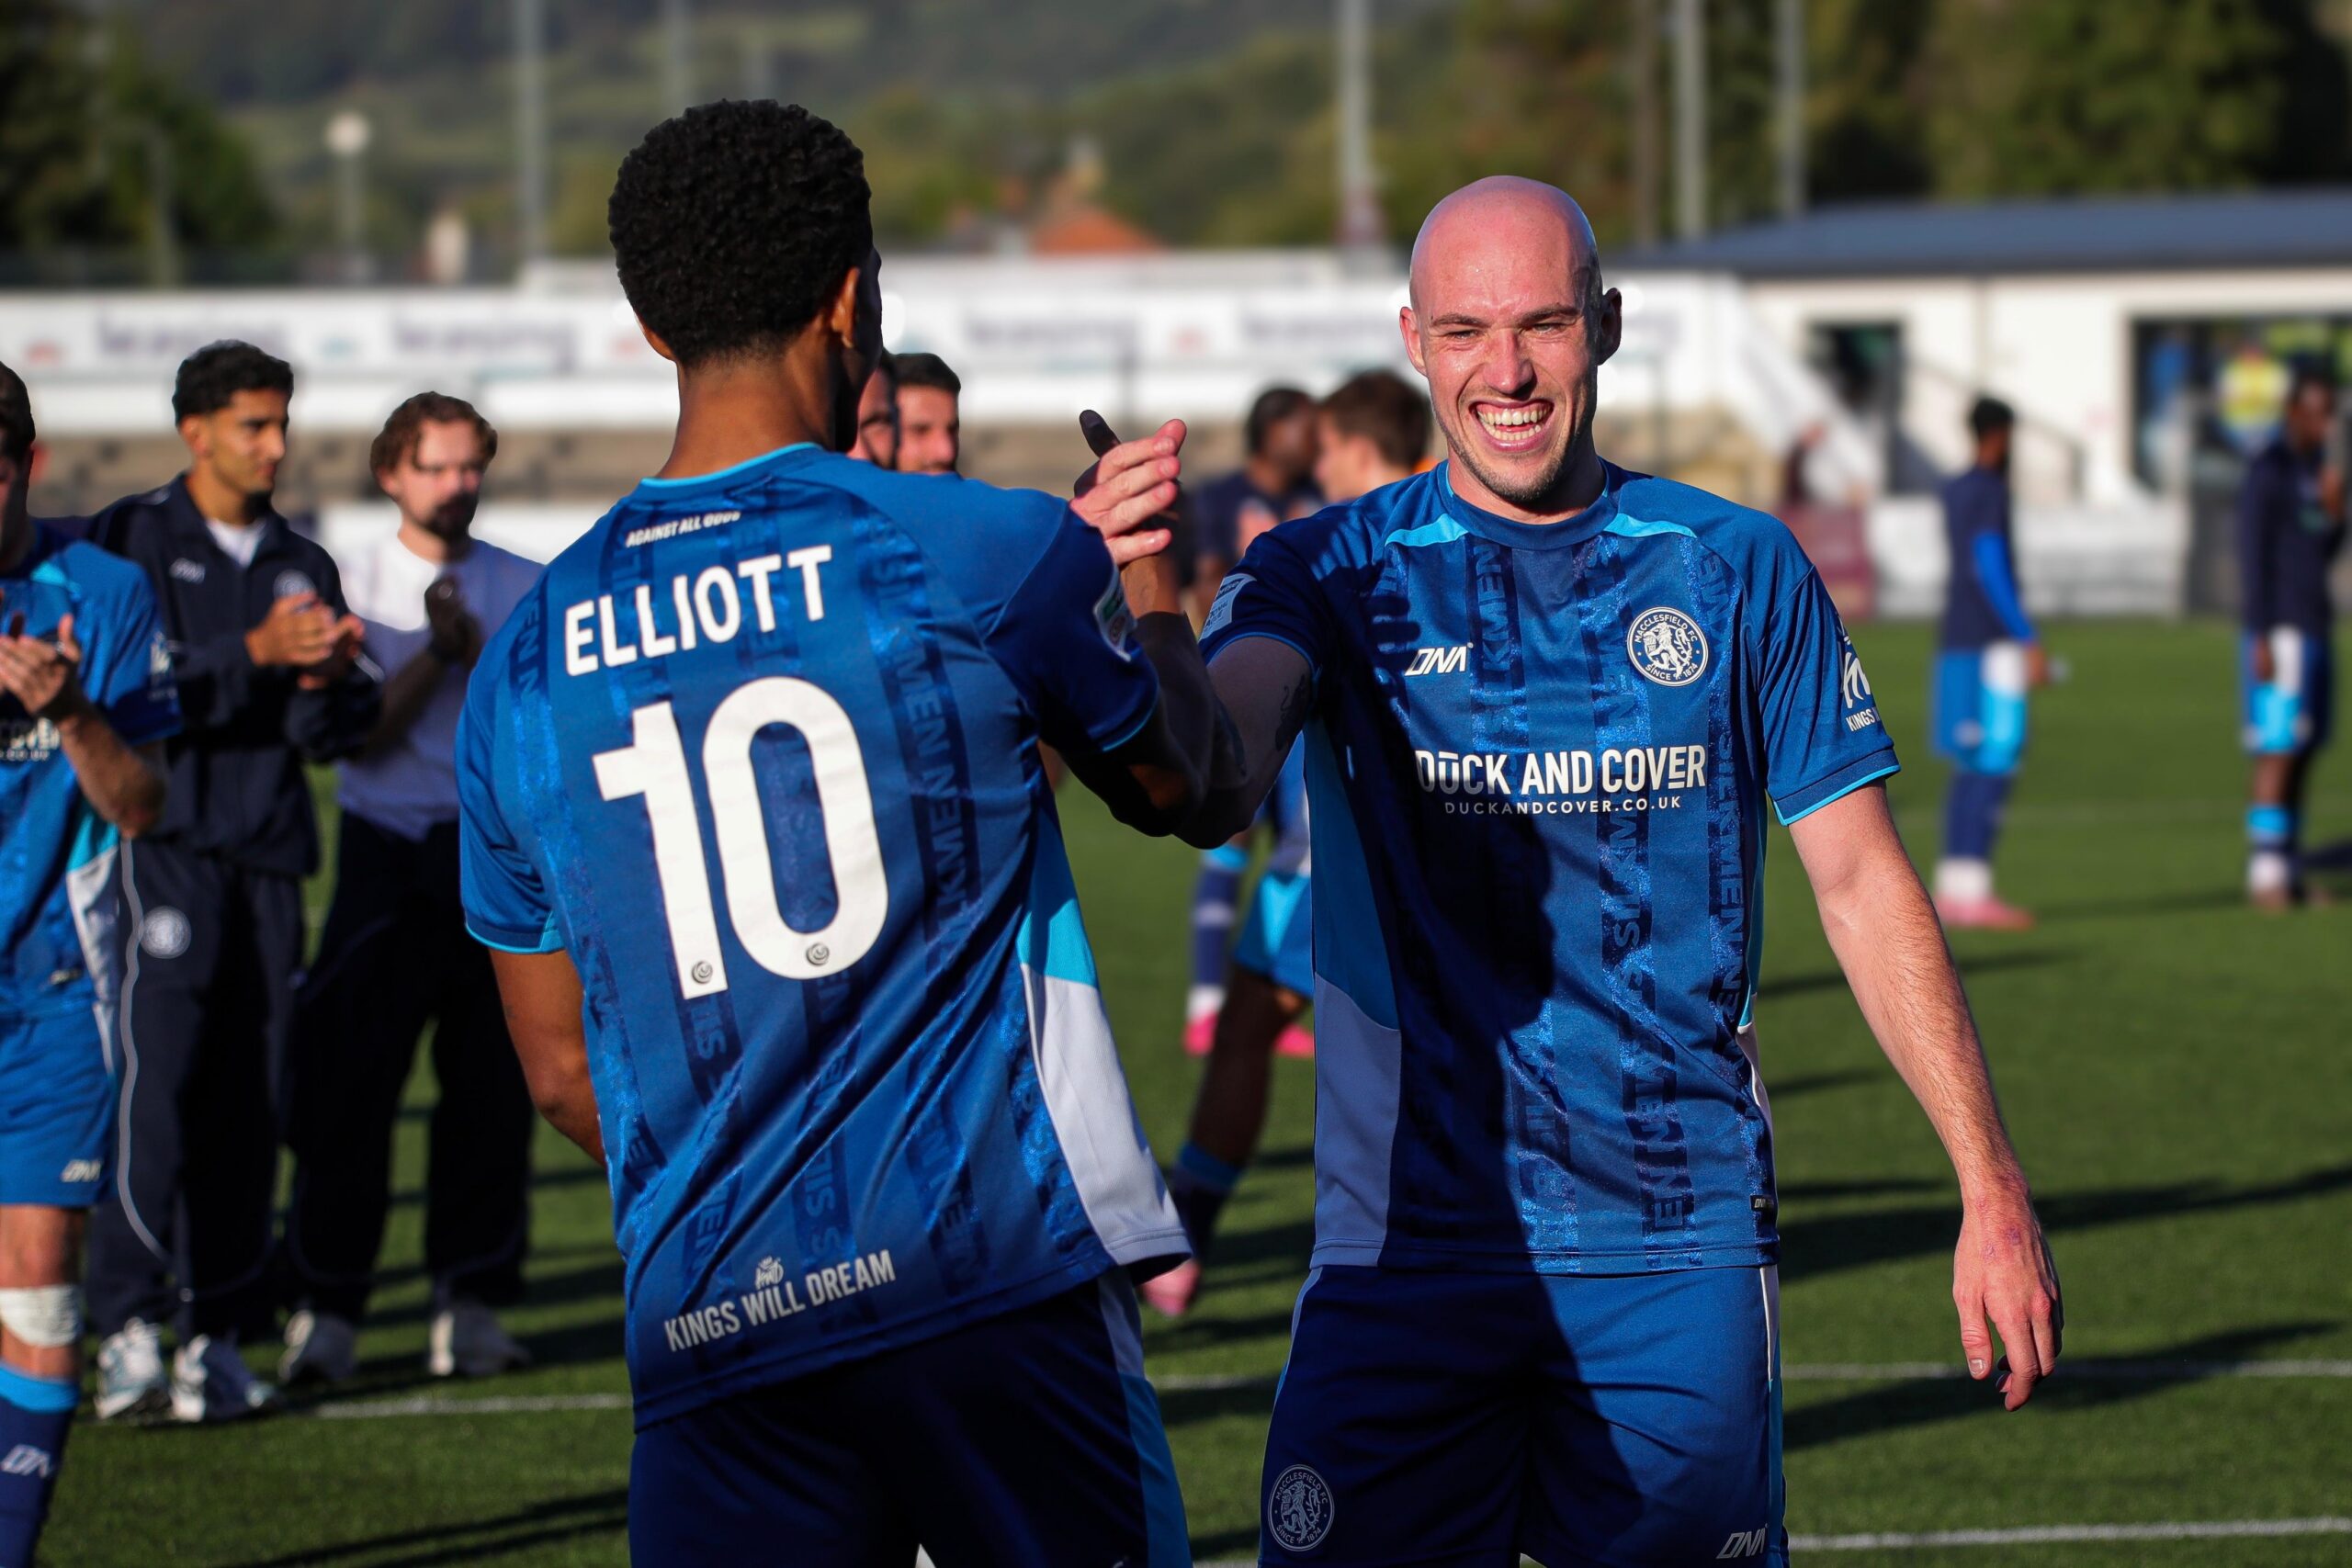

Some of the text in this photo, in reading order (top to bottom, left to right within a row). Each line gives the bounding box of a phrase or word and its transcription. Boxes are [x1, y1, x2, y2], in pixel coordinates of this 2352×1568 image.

[625, 520, 678, 548] AGAINST
[678, 516, 702, 535] ALL
[564, 544, 832, 677] ELLIOTT
[1634, 614, 1698, 643] MACCLESFIELD FC
[1404, 646, 1468, 676] DNA
[1645, 662, 1699, 681] SINCE 1874
[1845, 708, 1876, 732] KINGS
[1521, 750, 1594, 795] AND
[1601, 744, 1707, 794] COVER
[1444, 795, 1682, 815] DUCKANDCOVER.CO.UK
[592, 675, 889, 1000] 10
[664, 1248, 897, 1352] KINGS WILL DREAM
[1275, 1472, 1329, 1505] MACCLESFIELD FC
[1276, 1525, 1322, 1544] SINCE 1874
